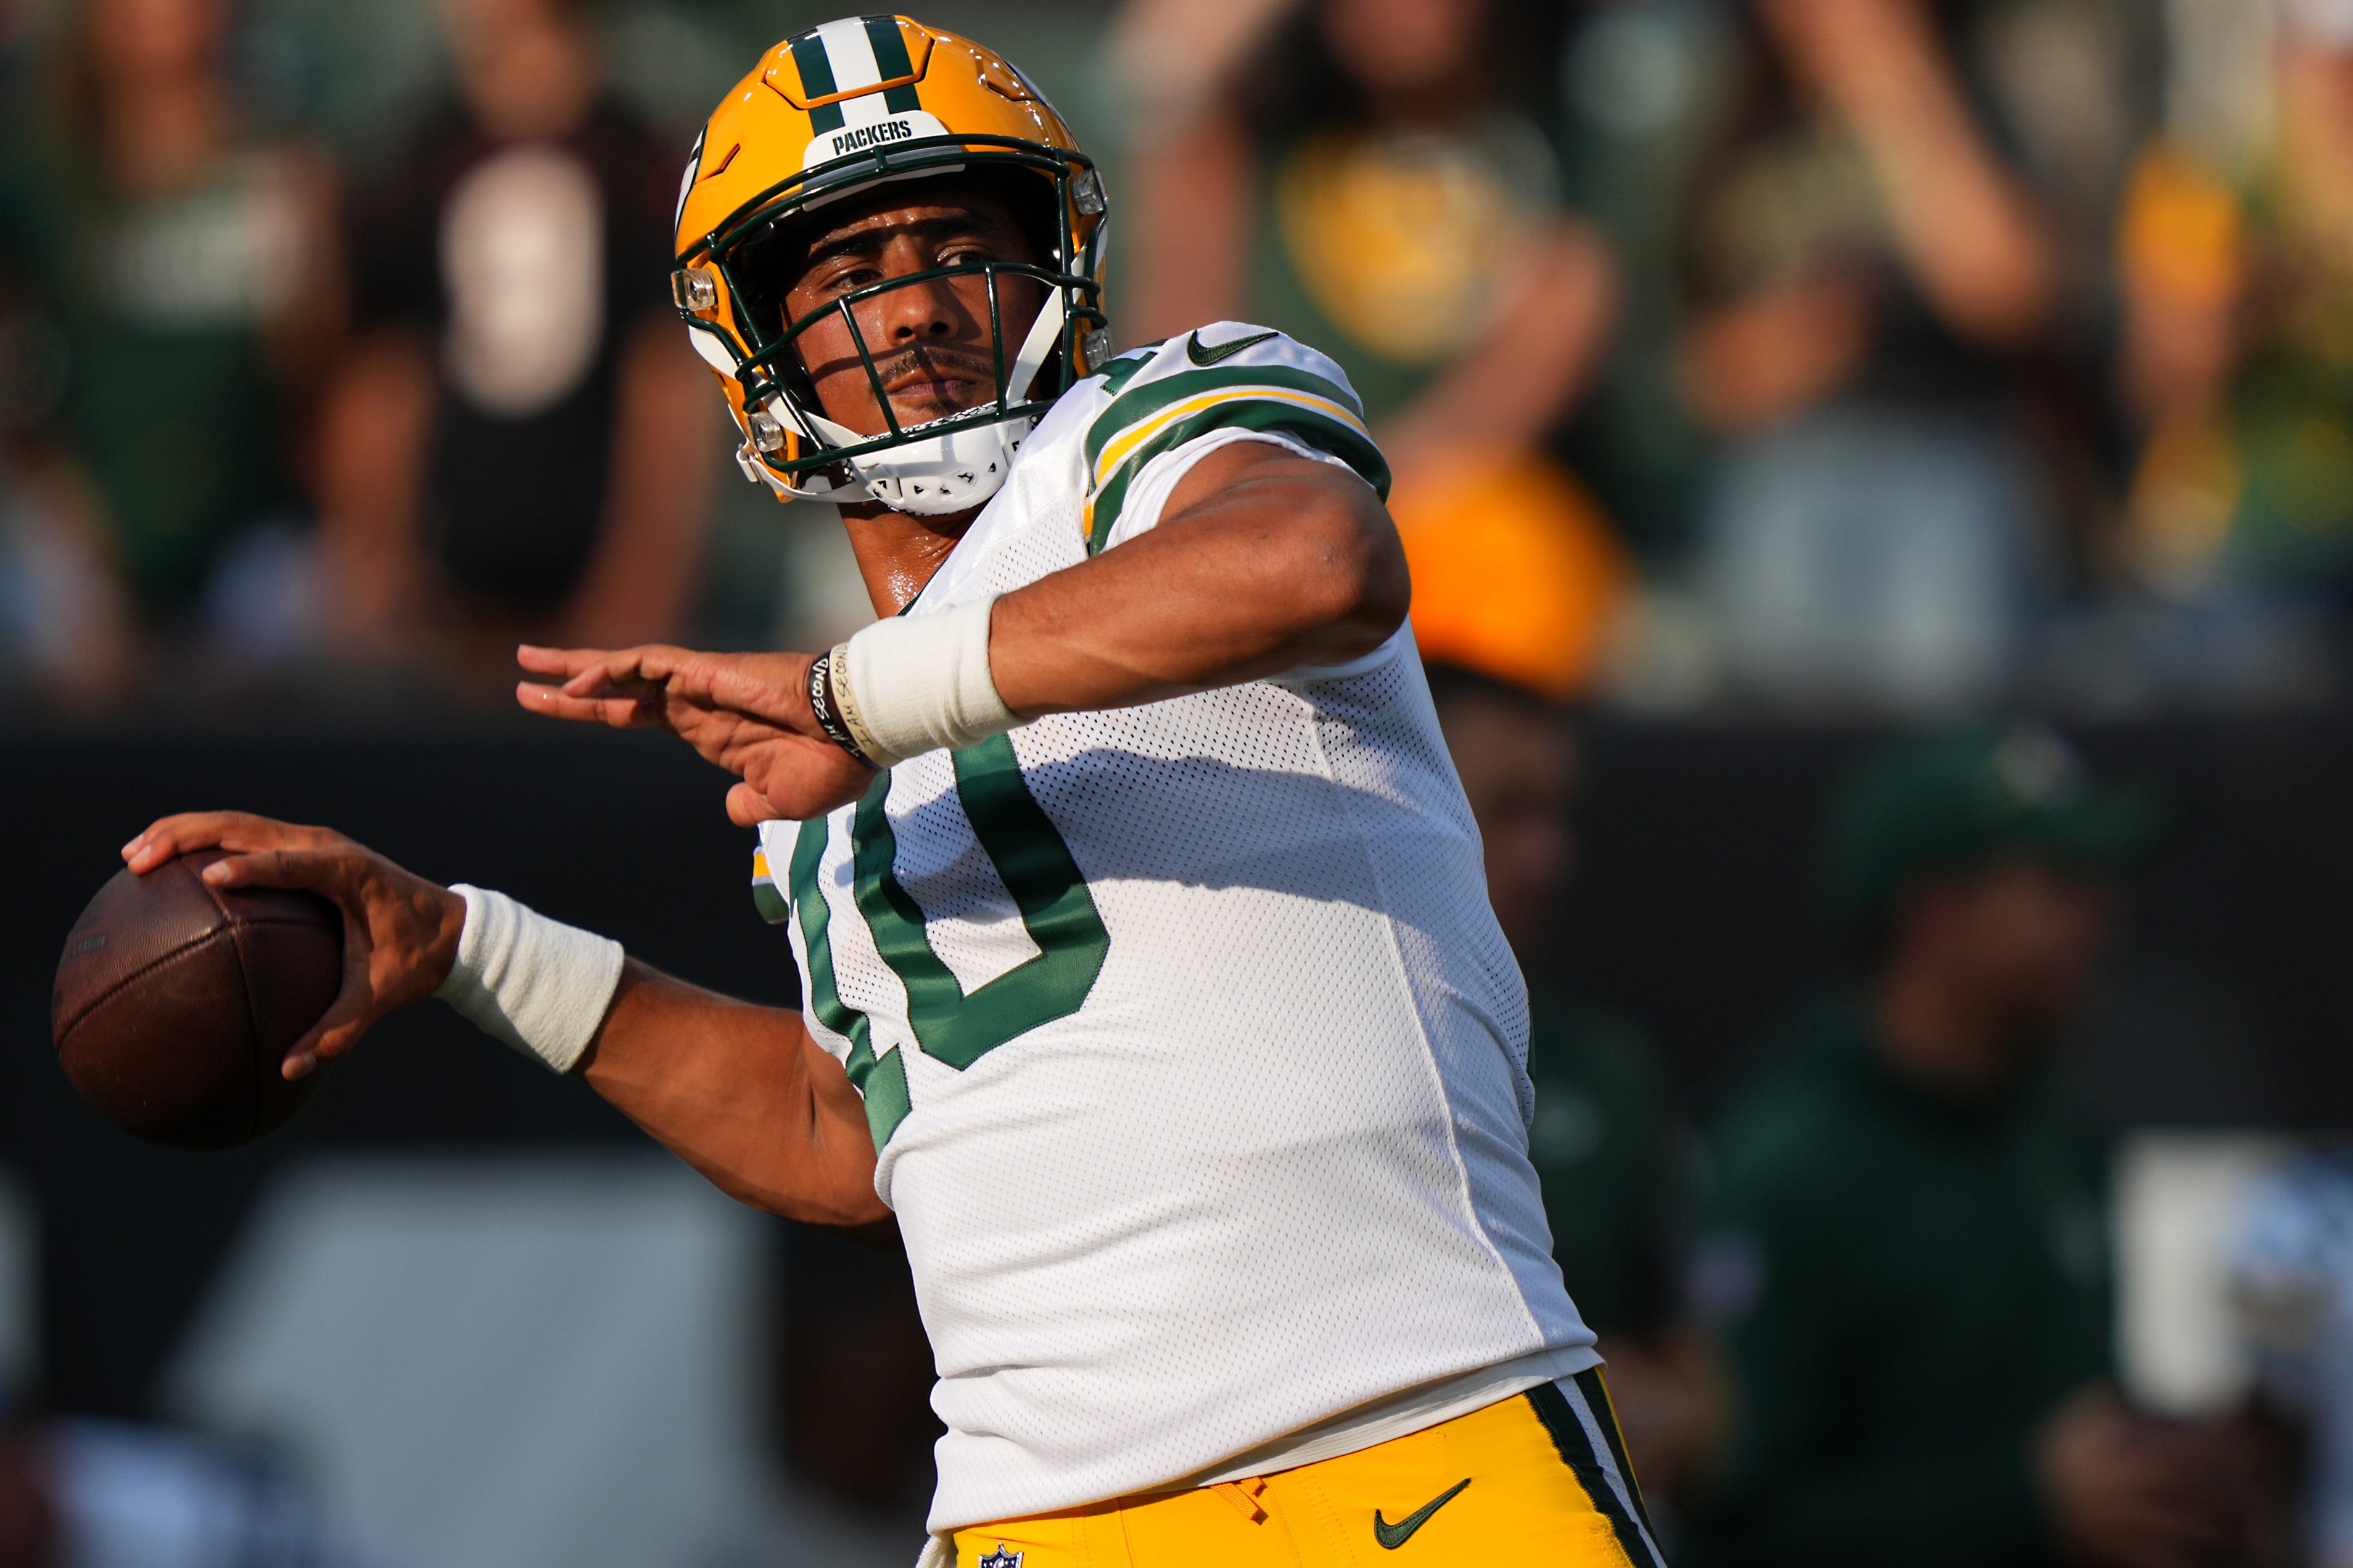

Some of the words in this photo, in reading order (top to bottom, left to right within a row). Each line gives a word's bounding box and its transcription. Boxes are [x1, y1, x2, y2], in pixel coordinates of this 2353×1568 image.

[833, 120, 912, 155] PACKERS
[812, 658, 830, 720] SECOND
[843, 705, 863, 727] AM
[856, 730, 874, 747] I
[788, 731, 1111, 1159] 10
